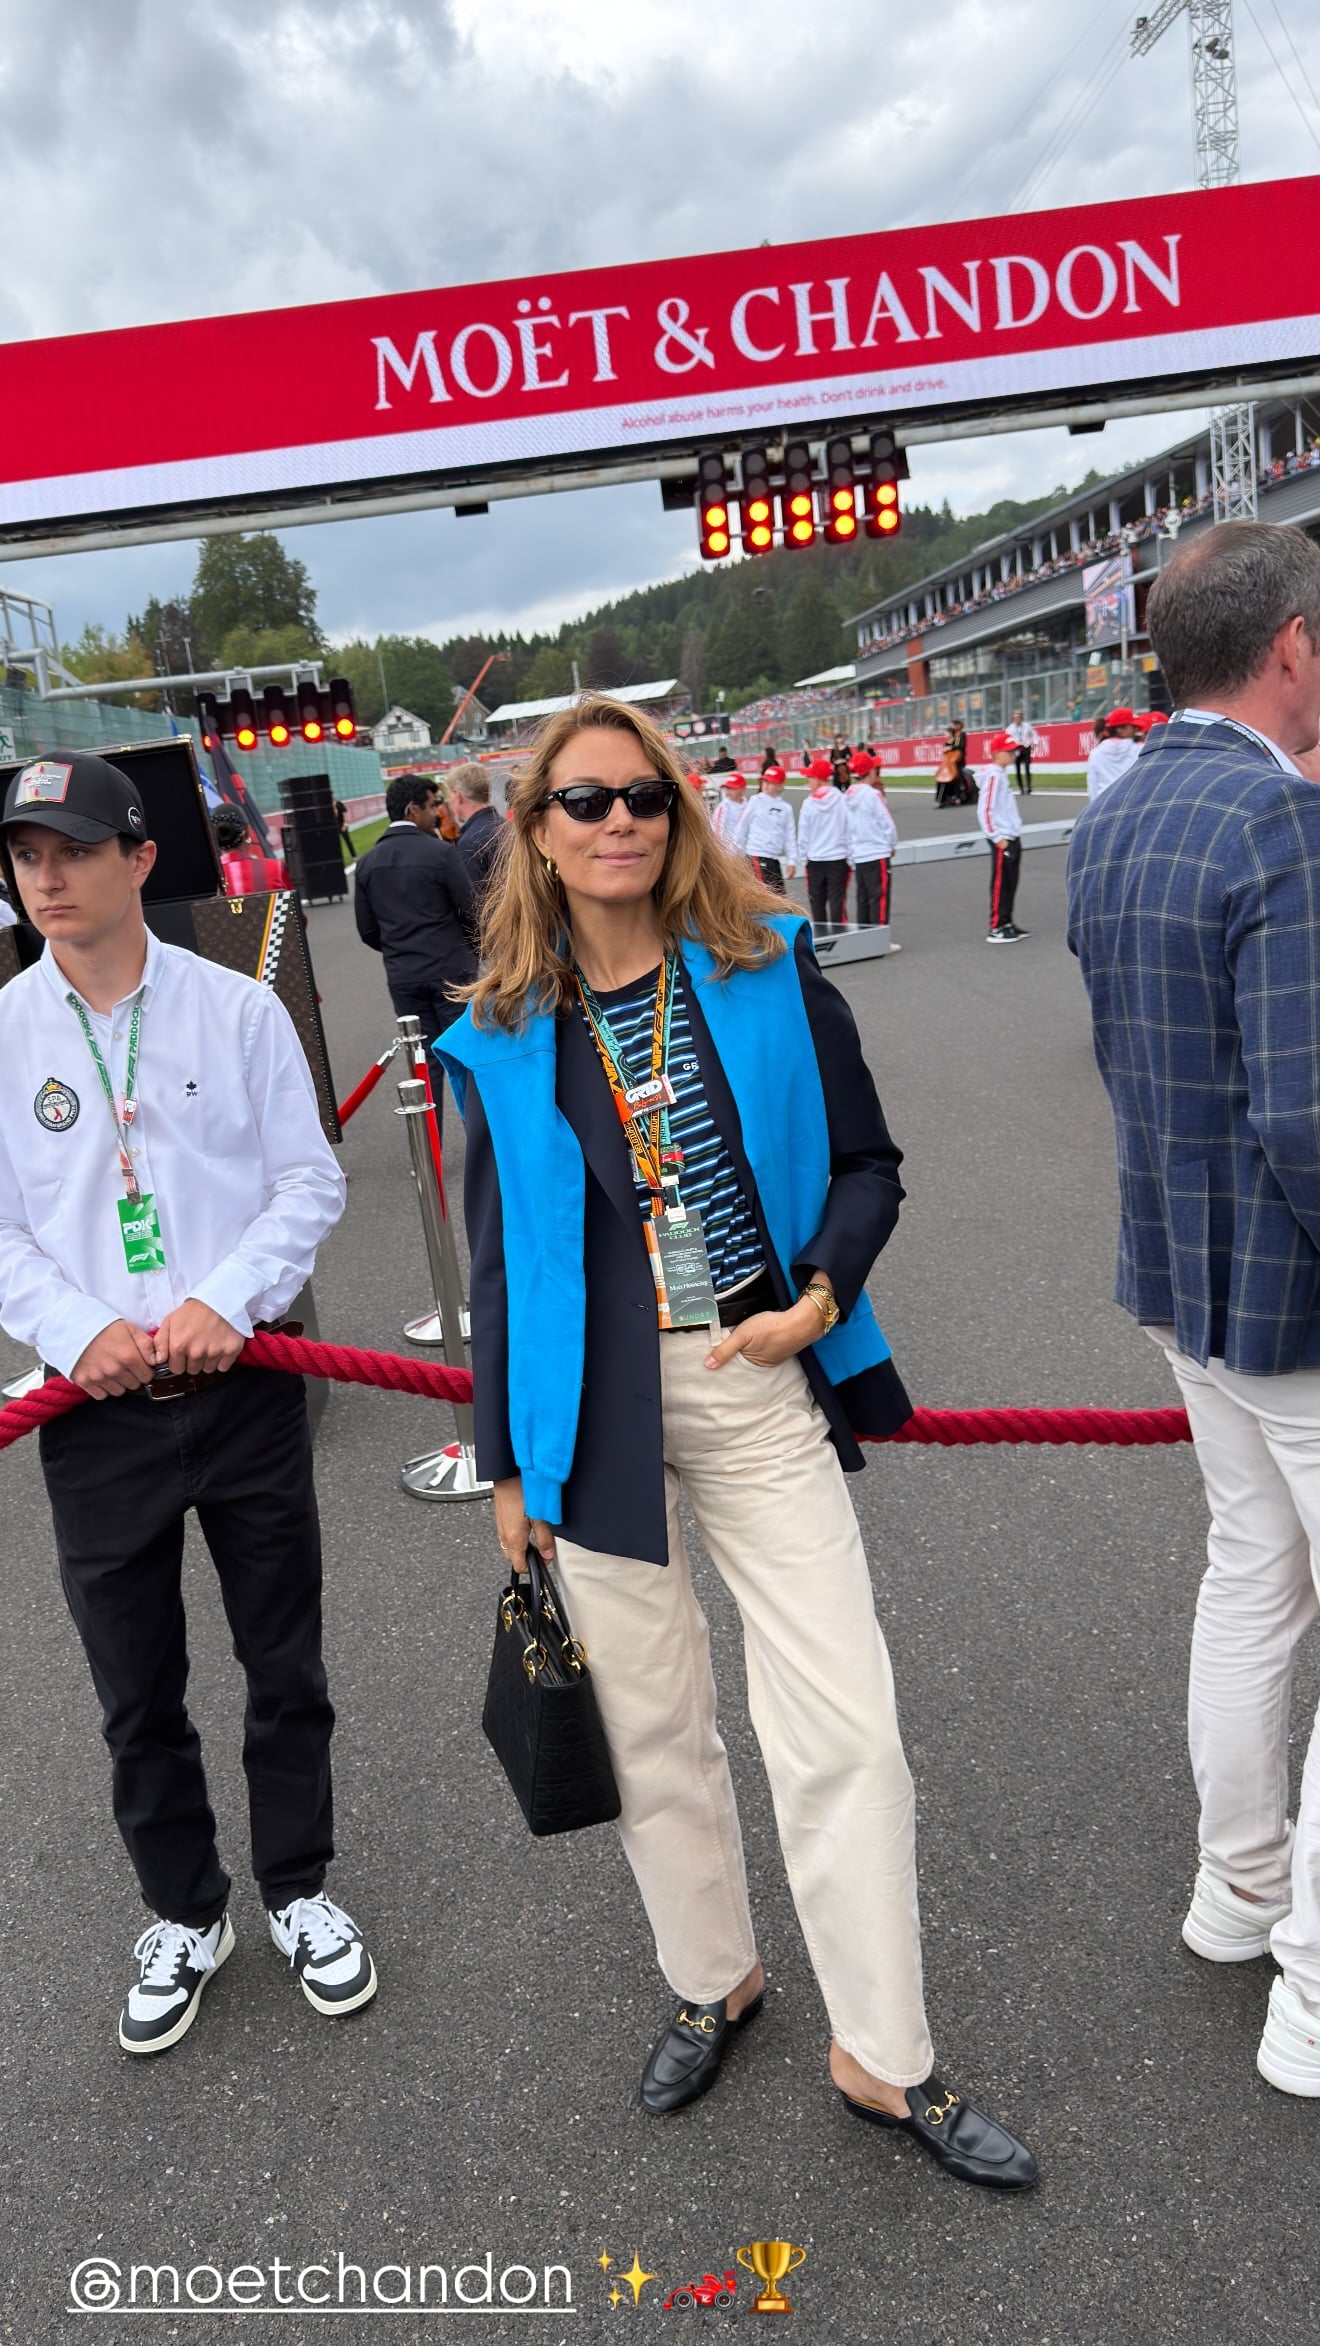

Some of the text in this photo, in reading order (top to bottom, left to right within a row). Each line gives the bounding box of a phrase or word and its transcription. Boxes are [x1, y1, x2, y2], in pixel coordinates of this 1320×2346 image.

[372, 234, 1181, 409] MOËT & CHANDON
[622, 378, 948, 429] Alcohol abuse harms your health. Don't drink and drive.
